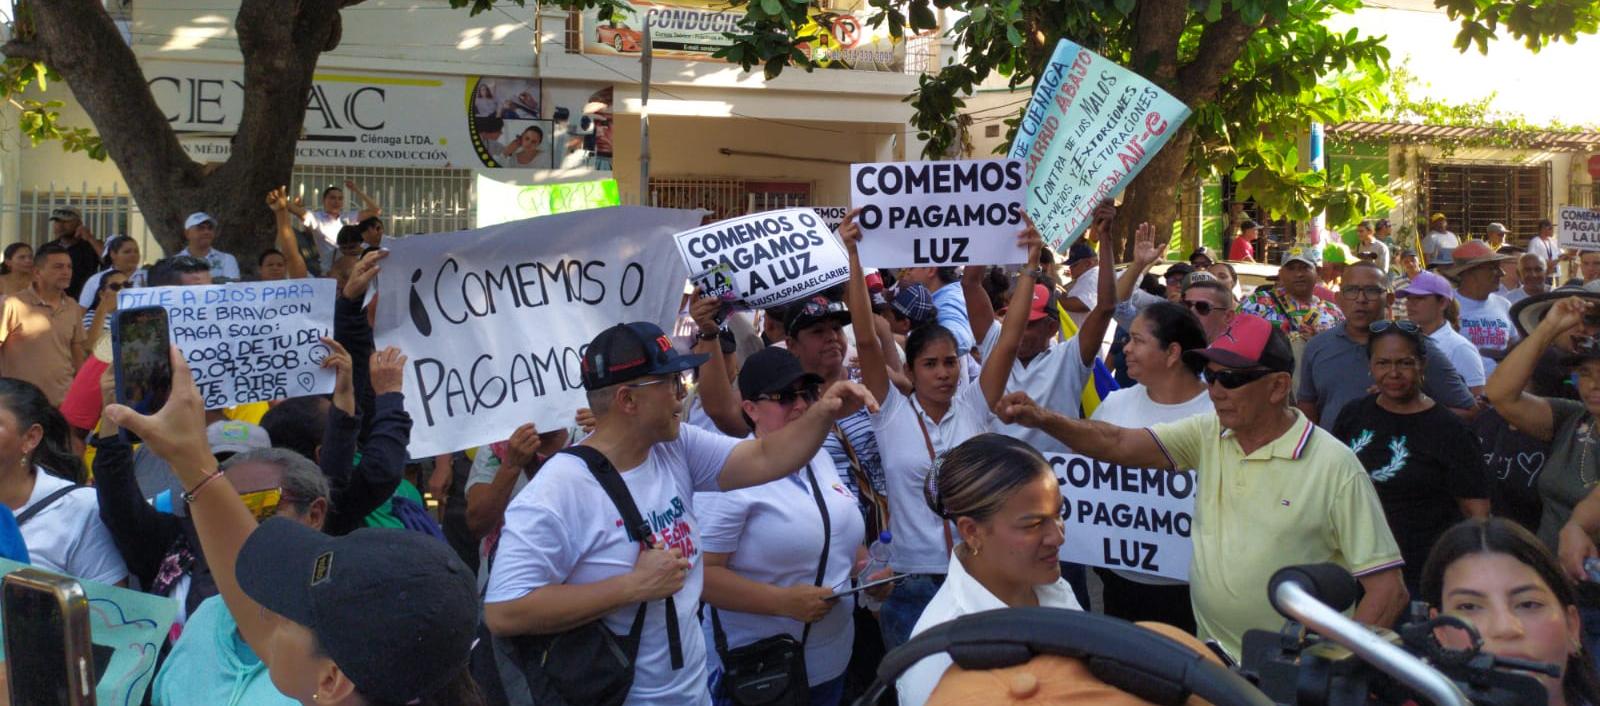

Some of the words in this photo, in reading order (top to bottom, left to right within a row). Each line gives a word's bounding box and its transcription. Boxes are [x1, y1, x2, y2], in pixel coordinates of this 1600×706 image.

[648, 8, 754, 34] CONDUCIE
[1055, 48, 1092, 117] ABAJO
[1079, 69, 1117, 123] MALOS
[361, 134, 401, 147] Ciénaga
[403, 135, 433, 146] LTDA.
[1075, 118, 1091, 138] LOS
[298, 146, 346, 159] ICENCIA
[350, 148, 367, 159] DE
[368, 148, 448, 161] CONDUCCIÓN
[1065, 136, 1077, 152] DE
[856, 161, 1022, 196] COMEMOS
[1033, 155, 1067, 205] CONTRA
[859, 204, 883, 230] O
[889, 201, 1022, 229] PAGAMOS
[688, 215, 794, 258] COMEMOS
[799, 213, 817, 228] O
[1572, 231, 1589, 242] LA
[913, 237, 970, 264] LUZ
[768, 251, 819, 287] LUZ
[183, 289, 197, 305] A
[205, 288, 258, 303] DIOS
[262, 283, 315, 301] PARA
[620, 262, 645, 306] O
[215, 305, 277, 322] BRAVO
[281, 302, 312, 317] CON
[172, 325, 223, 344] PAGA
[228, 322, 281, 338] SOLO:
[238, 341, 264, 357] DE
[268, 335, 292, 350] TU
[234, 372, 288, 392] AIRE
[234, 387, 288, 403] CASA
[1049, 456, 1199, 500] COMEMO
[1077, 500, 1193, 538] PAGAMO
[1103, 538, 1159, 572] LUZ
